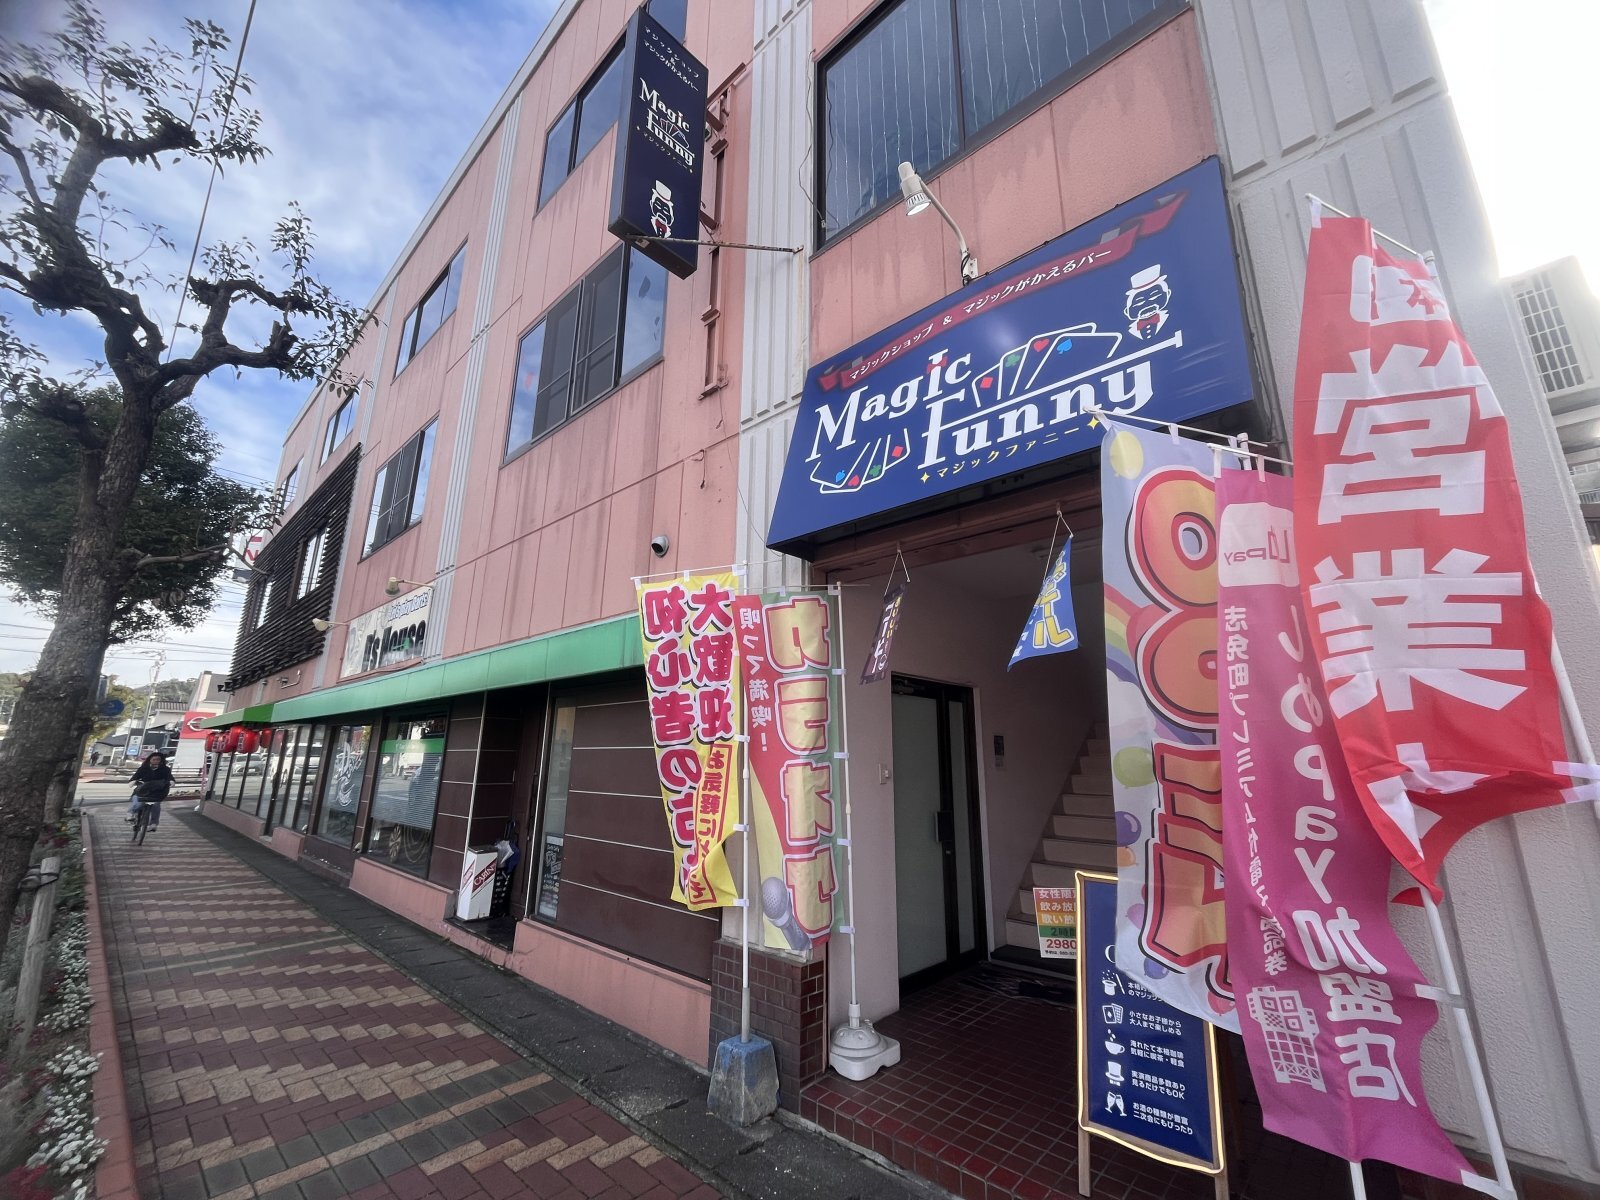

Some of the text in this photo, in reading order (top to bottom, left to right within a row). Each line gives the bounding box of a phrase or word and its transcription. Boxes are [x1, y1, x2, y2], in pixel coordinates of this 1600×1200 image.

[639, 77, 690, 133] Magic
[646, 108, 695, 166] Funny
[848, 249, 1112, 382] マジックショップ & マジックがかえるバー
[805, 348, 972, 463] Magic
[917, 331, 1183, 471] Funny
[936, 426, 1080, 479] マジックファニー
[1040, 901, 1077, 912] 飲み放
[1041, 913, 1077, 925] 歌い放
[1046, 938, 1077, 950] 2980
[1129, 1011, 1182, 1028] 小さなお子様から
[1129, 1018, 1182, 1035] 大人まで楽しめる
[1132, 1078, 1185, 1100] 見るだけでもOK
[1133, 1110, 1193, 1135] 二次会にもぴったり
